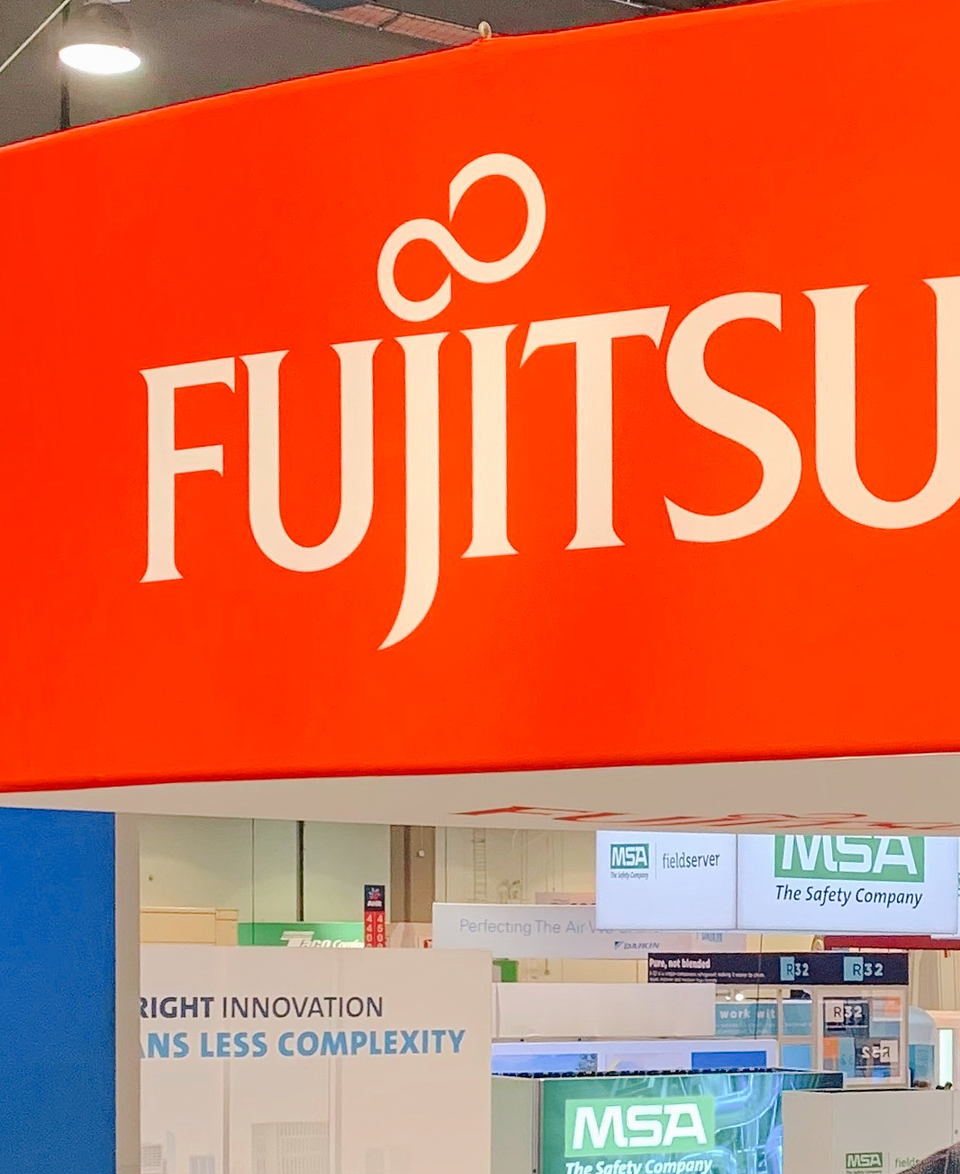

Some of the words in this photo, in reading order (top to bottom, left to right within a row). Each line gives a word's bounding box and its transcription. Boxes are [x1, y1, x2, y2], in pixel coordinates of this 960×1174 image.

[612, 846, 648, 867] MSA
[662, 852, 720, 869] fieldserver
[781, 836, 918, 875] MSA
[775, 885, 802, 901] The
[806, 885, 852, 907] Safety
[855, 888, 923, 909] Company
[460, 919, 532, 937] Perfecting
[535, 920, 561, 934] The
[566, 920, 587, 934] Air
[786, 963, 810, 976] R32
[852, 963, 884, 977] R32
[222, 996, 383, 1018] INNOVATION
[833, 1005, 863, 1018] R32
[201, 1032, 267, 1057] LESS
[278, 1029, 466, 1056] COMPLEXITY
[572, 1103, 707, 1150] MSA
[847, 1154, 881, 1167] MSA
